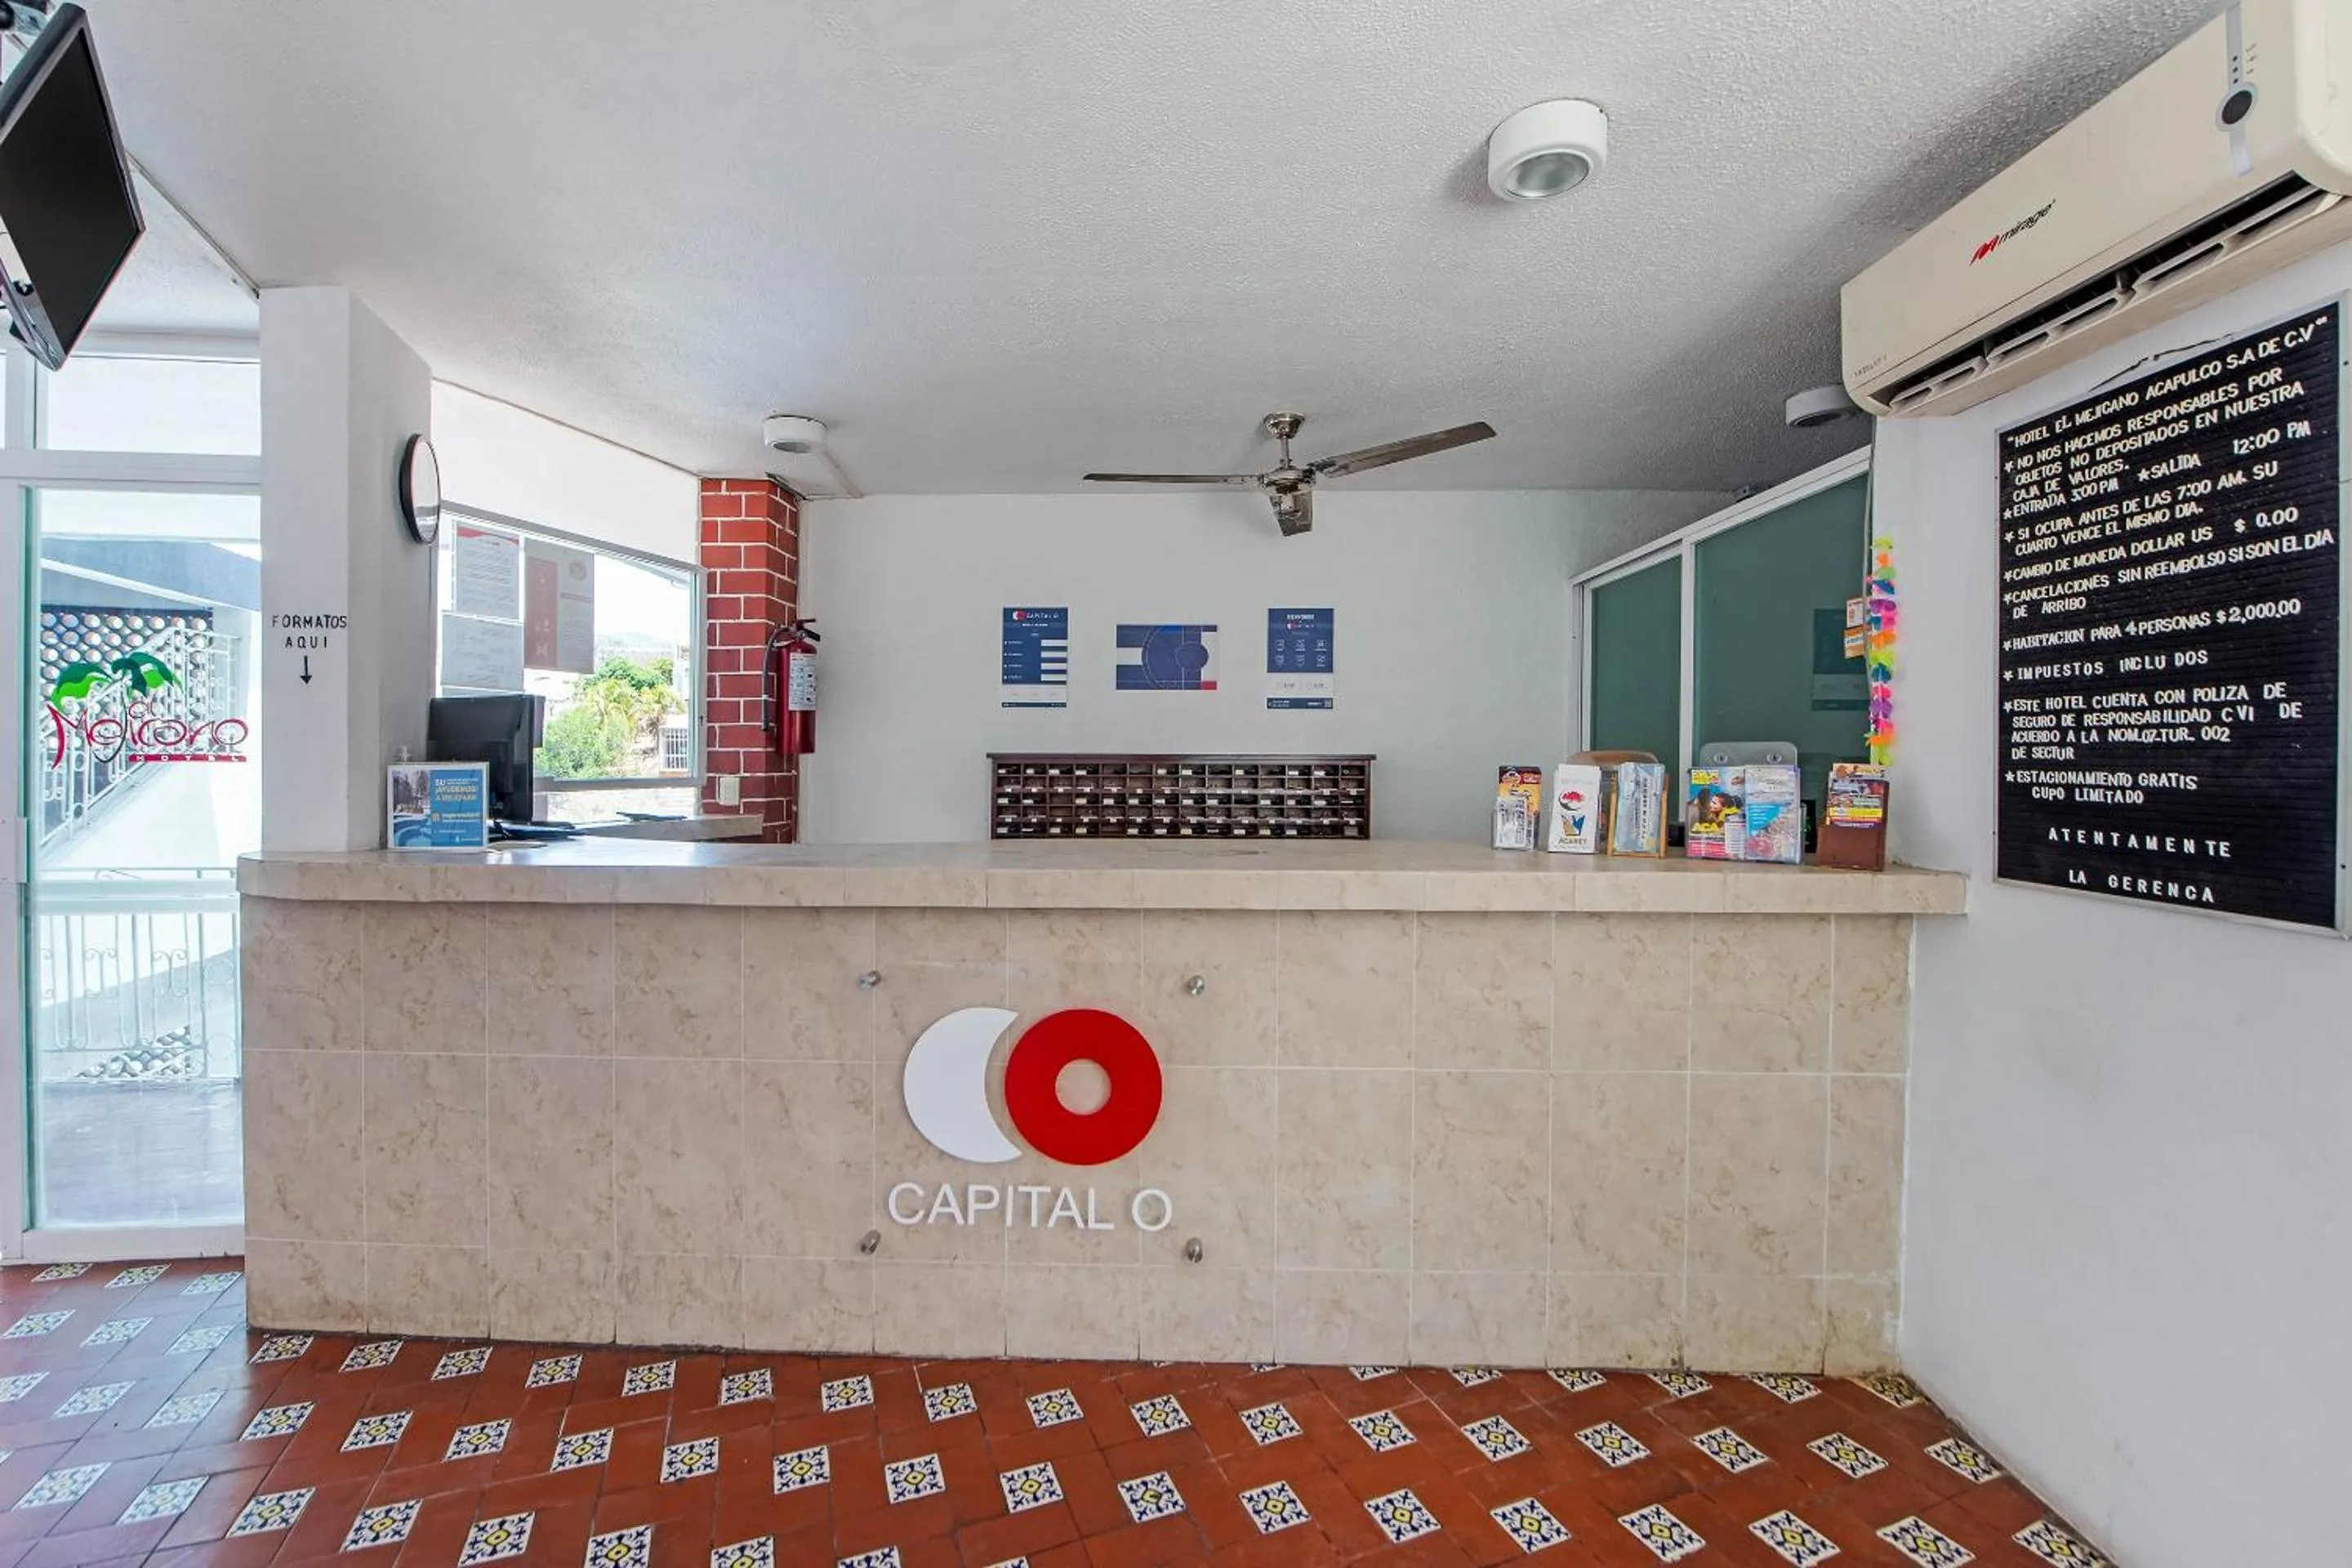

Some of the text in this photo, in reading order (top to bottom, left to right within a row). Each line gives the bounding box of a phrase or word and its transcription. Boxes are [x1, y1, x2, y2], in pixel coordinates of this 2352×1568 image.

[2055, 415, 2072, 433] EL
[2075, 391, 2139, 425] MEJICANO
[2145, 361, 2221, 400] ACAPULCO
[2258, 336, 2281, 359] DE
[2015, 381, 2305, 486] OBJETOS NO DEPOSITADOS EN NUESTRA
[2017, 367, 2283, 469] NO NOS HACEMOS RESPONSABLES POR
[2012, 493, 2067, 517] ENTRADA
[2099, 477, 2120, 493] PM
[2150, 452, 2203, 480] SALIDA
[2232, 427, 2281, 455] 12:00
[2286, 420, 2311, 439] PM
[2012, 458, 2130, 502] CAJA DE VALORES.
[2018, 527, 2030, 541] SI
[2034, 516, 2074, 536] OCUPA
[2078, 504, 2119, 526] ANTES
[2123, 497, 2140, 514] DE
[2145, 489, 2172, 510] LAS
[2177, 479, 2212, 500] 7:00
[2252, 460, 2278, 480] SU
[2012, 562, 2053, 581] CAMBIO
[2055, 557, 2071, 572] DE
[2073, 545, 2127, 568] MONEDA
[2130, 532, 2185, 556] DOLLAR
[2191, 526, 2213, 543] US
[2256, 506, 2299, 528] 0.00
[2015, 536, 2058, 556] CUARTO
[2061, 524, 2103, 546] VENCE
[2105, 521, 2122, 536] EL
[2125, 508, 2171, 531] MISMO
[2012, 528, 2335, 604] CANCELACIONES SIN REEMBOLSO SI SON EL DIA
[272, 613, 348, 630] FORMATOS
[2012, 596, 2087, 619] DE ARRIBO
[284, 635, 327, 649] AQUI
[2012, 628, 2085, 650] HABITACION
[2090, 623, 2123, 643] PARA
[2138, 612, 2212, 636] PERSONAS
[2017, 661, 2105, 680] IMPUESTOS
[2012, 715, 2056, 728] SEGURO
[2061, 713, 2077, 727] DE
[2083, 708, 2212, 727] RESPONSABILIDAD
[2278, 702, 2303, 719] DE
[2013, 681, 2287, 713] ESTE HOTEL CUENTA CON POLIZA DE
[2011, 730, 2060, 742] ACUERDO
[2066, 729, 2076, 742] A
[2082, 728, 2100, 744] LA
[2011, 746, 2075, 761] DE SECTUR
[2016, 770, 2198, 791] ESTACIONAMIENTO GRATIS
[2031, 786, 2145, 804] CUPO LIMITADO
[2068, 869, 2215, 903] LA GERENCA
[888, 1181, 1174, 1232] CAPITAL O
